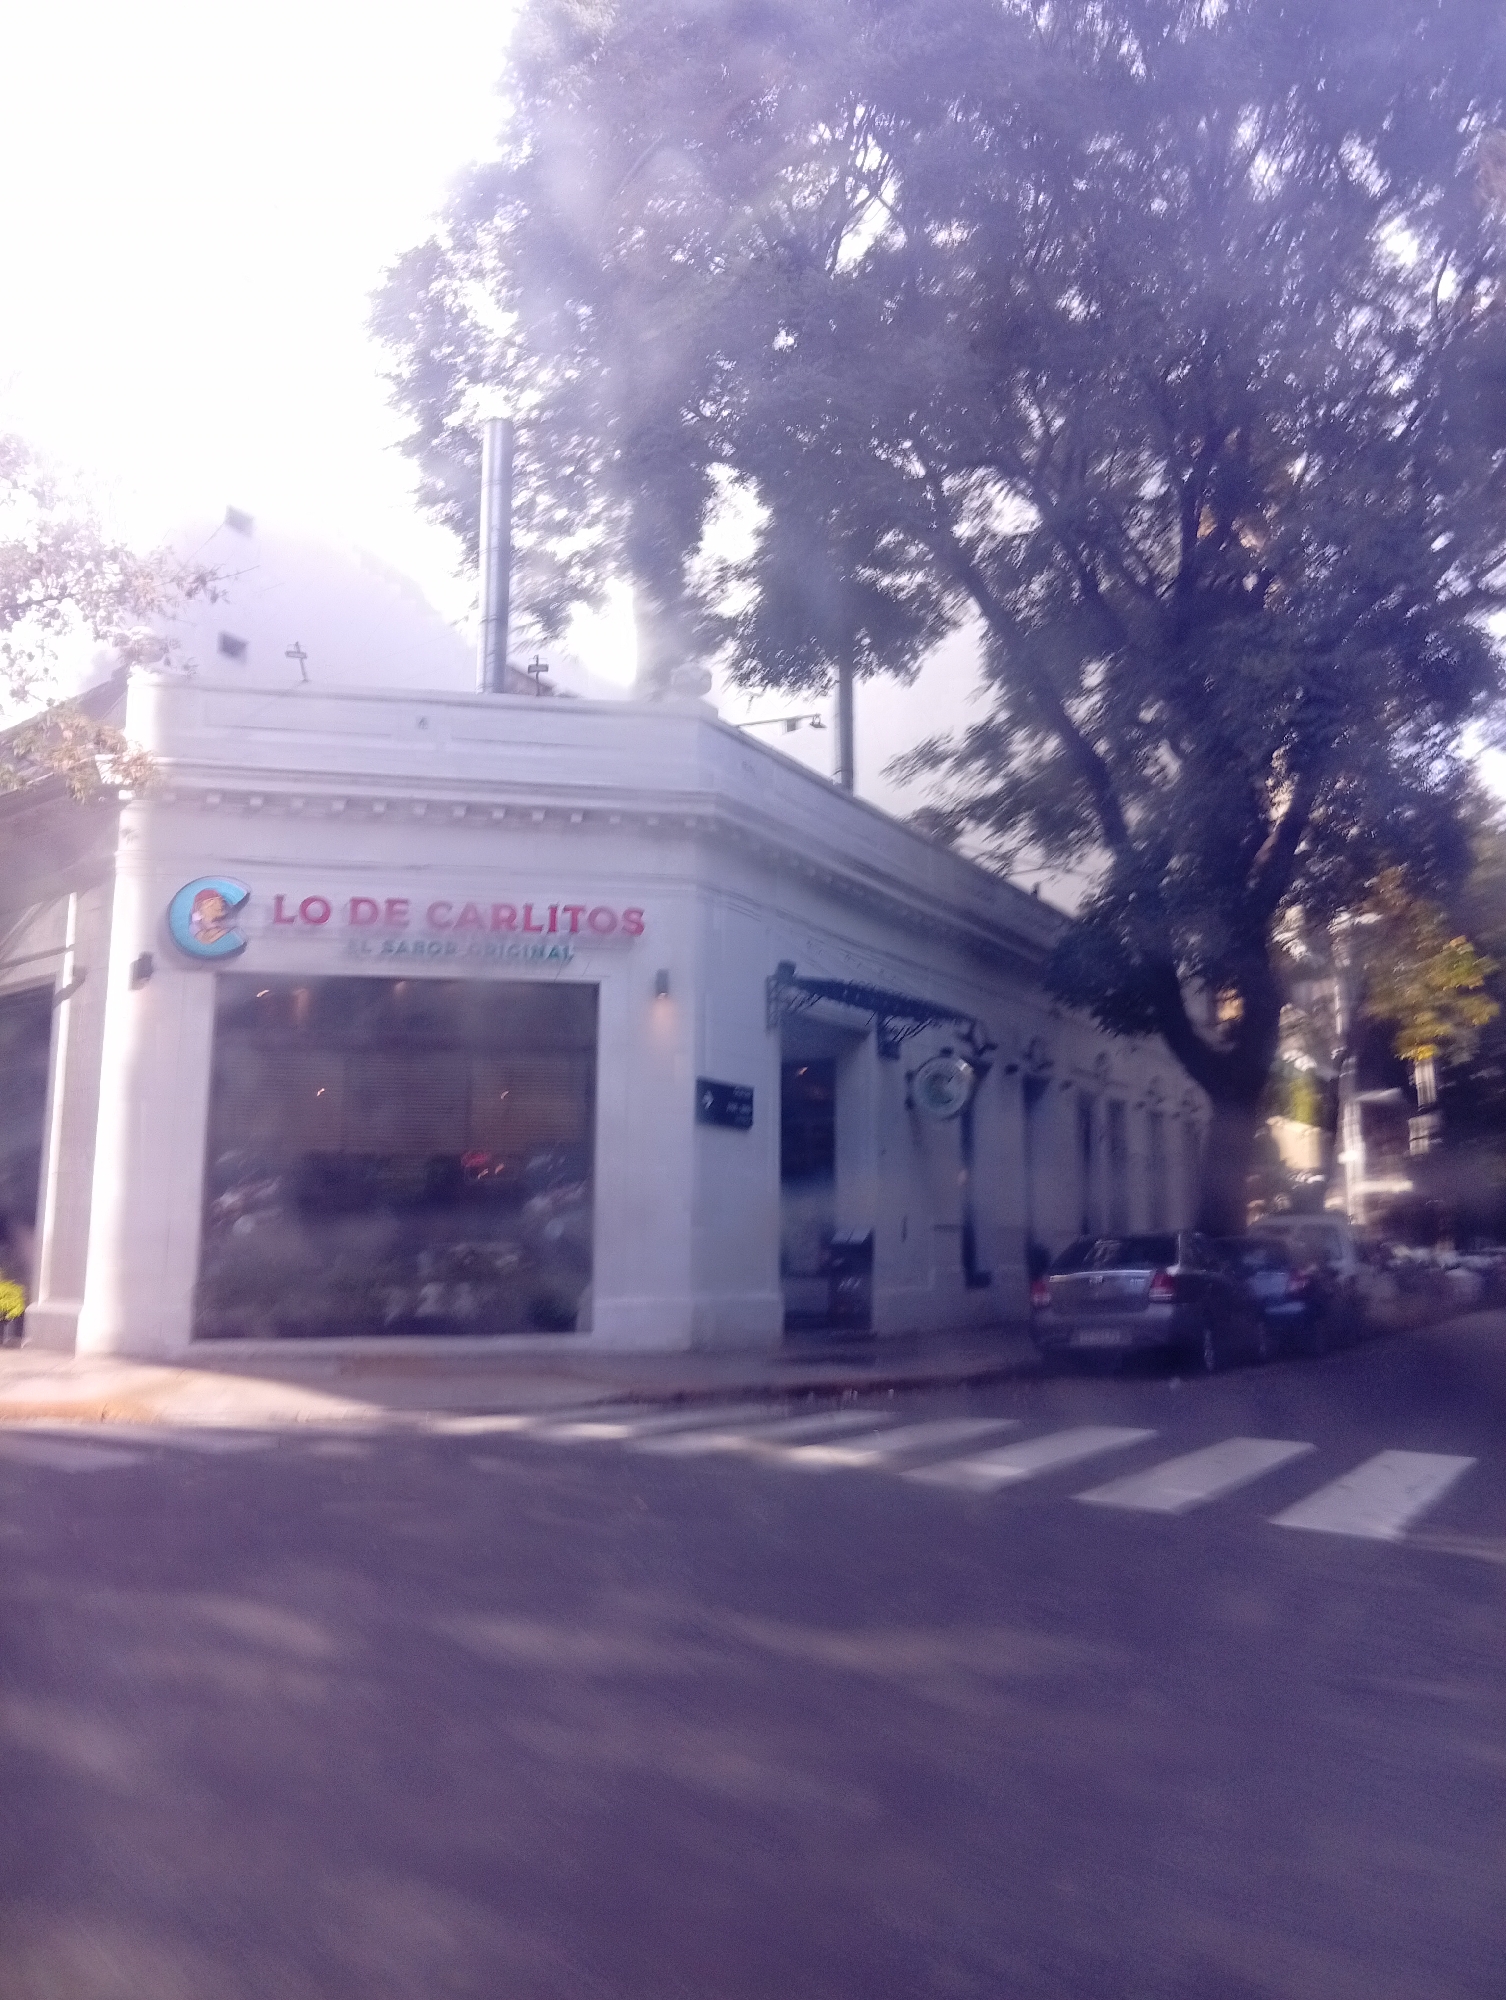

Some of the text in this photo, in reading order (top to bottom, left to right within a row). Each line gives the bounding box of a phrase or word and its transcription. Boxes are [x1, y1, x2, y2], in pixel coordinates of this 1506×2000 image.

[273, 893, 645, 937] LO DE CARLITOS
[381, 939, 458, 956] SABOR
